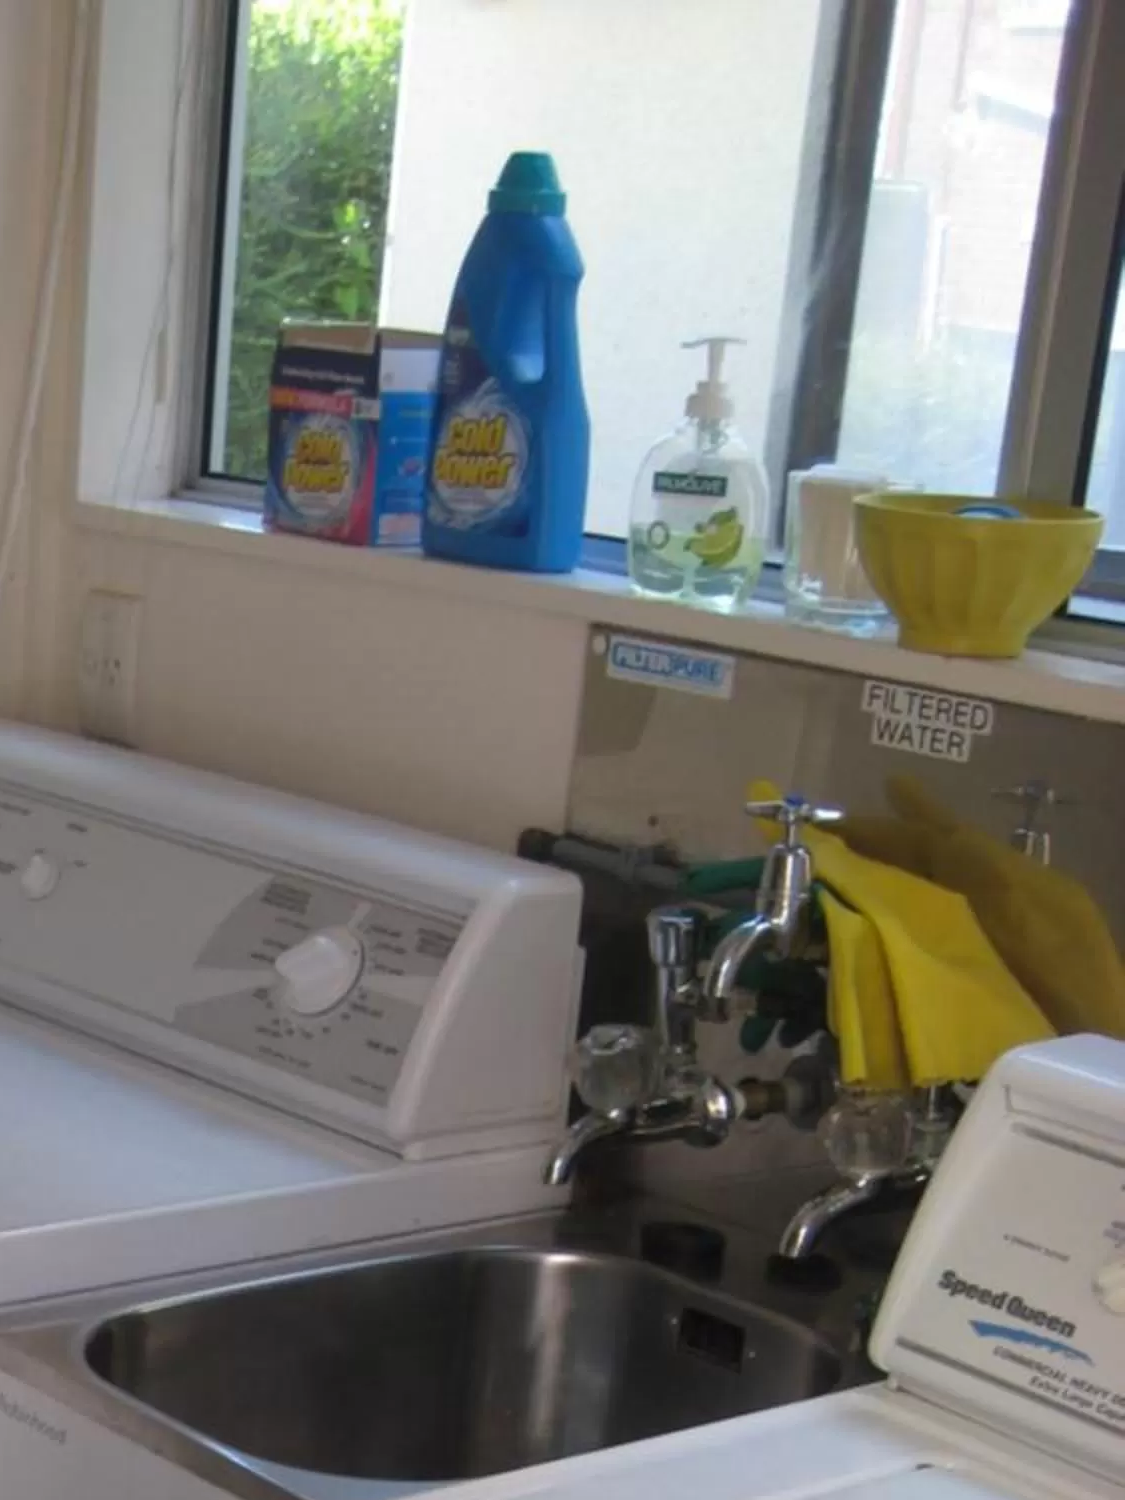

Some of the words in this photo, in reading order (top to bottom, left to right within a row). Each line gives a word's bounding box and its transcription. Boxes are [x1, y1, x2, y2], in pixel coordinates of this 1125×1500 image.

[867, 684, 988, 730] FILTERED
[876, 719, 964, 757] WATER
[938, 1269, 1008, 1310] Speed
[1006, 1296, 1077, 1338] Queen
